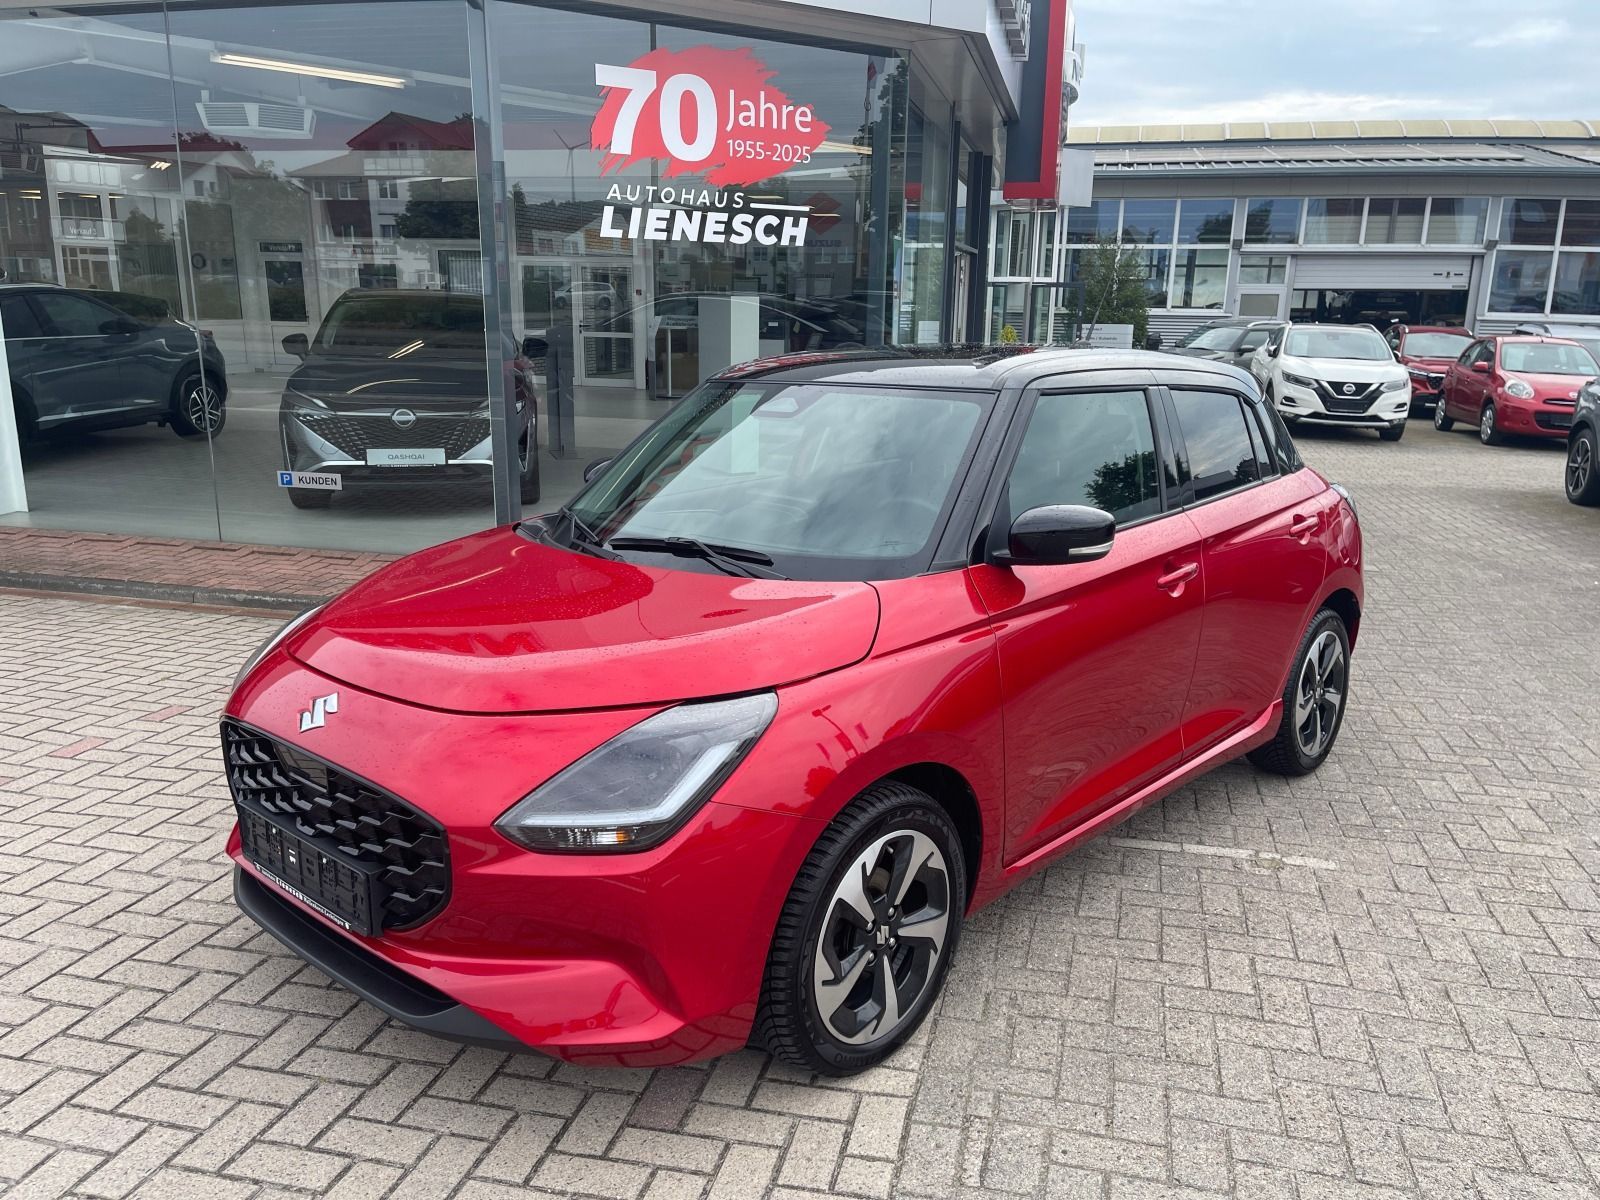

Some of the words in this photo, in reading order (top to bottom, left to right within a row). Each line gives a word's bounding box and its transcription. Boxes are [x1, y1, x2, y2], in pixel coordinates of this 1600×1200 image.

[594, 63, 718, 162] 70
[725, 89, 812, 133] Jahre
[727, 139, 812, 164] 1955-2025
[606, 183, 745, 209] AUTOHAUS
[599, 205, 809, 247] LIENESCH
[298, 475, 337, 486] KUNDEN
